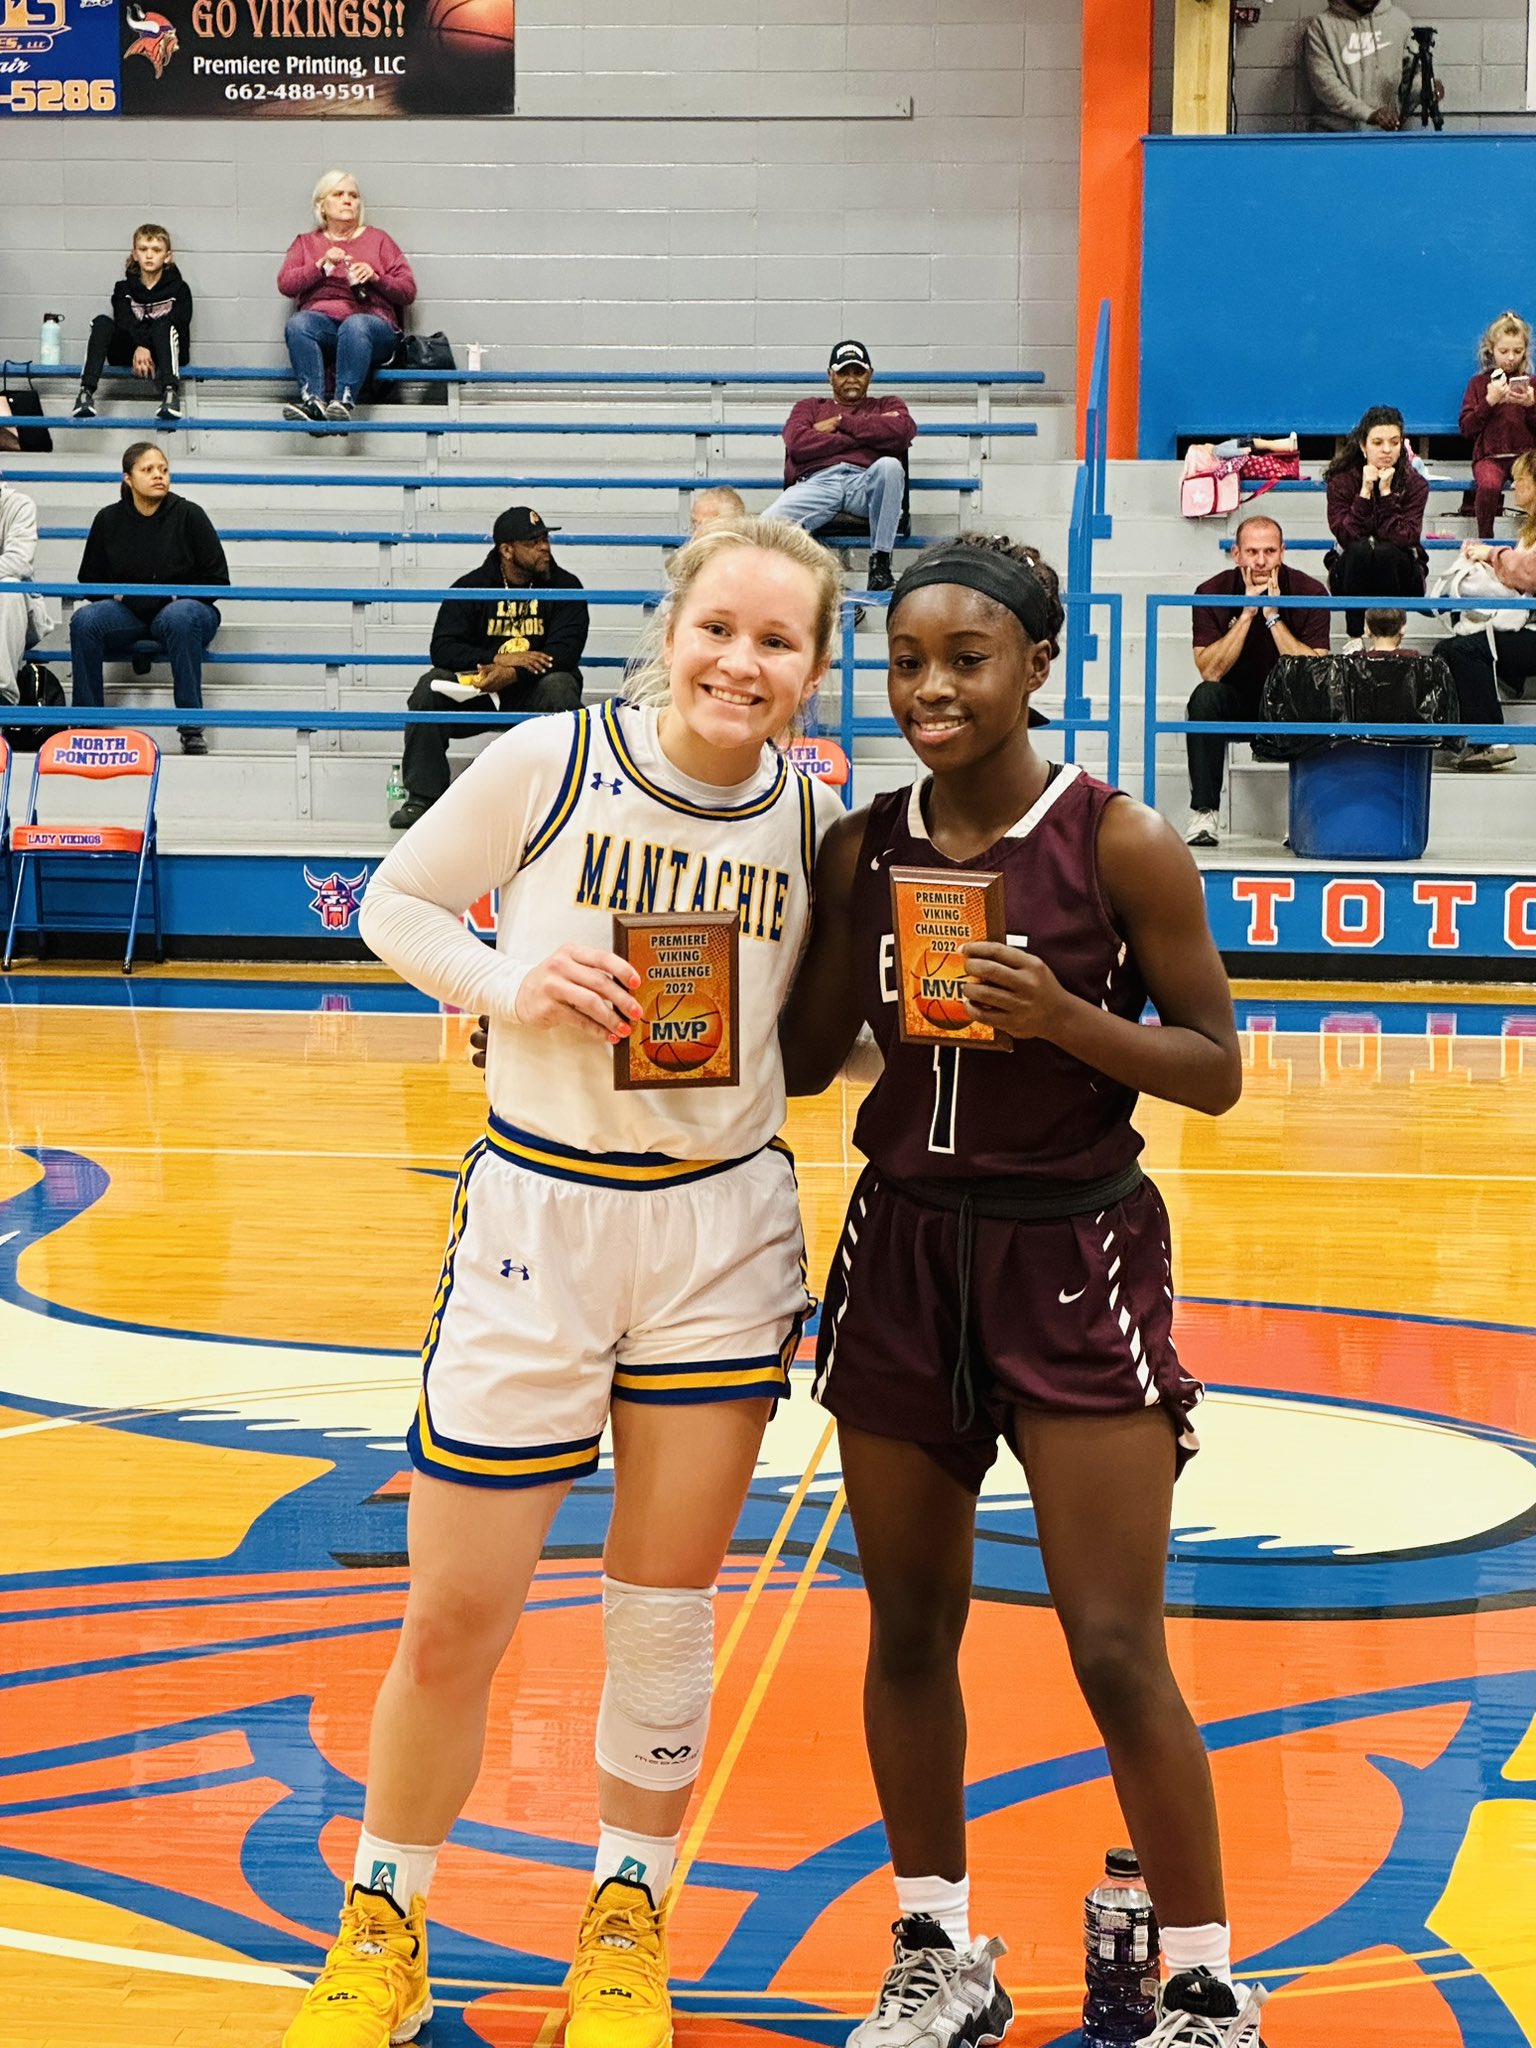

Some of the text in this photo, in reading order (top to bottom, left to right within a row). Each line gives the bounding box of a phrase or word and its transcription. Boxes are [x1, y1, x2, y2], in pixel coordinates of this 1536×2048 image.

[192, 0, 405, 38] GO VIKINGS!!
[193, 56, 406, 78] Premiere Printing, LLC
[224, 83, 375, 100] 662-488-9591
[71, 737, 126, 751] NORTH
[55, 750, 138, 765] PONTOTOC
[28, 834, 102, 845] LADY VIKINGS
[575, 831, 790, 943] MANTACHIE
[915, 891, 966, 905] PREMIERE
[923, 908, 960, 921] VIKING
[915, 923, 971, 937] CHALLENGE
[651, 934, 708, 947] PREMIERE
[931, 940, 957, 952] 2022
[658, 949, 700, 962] VIKING
[647, 965, 711, 979] CHALLENGE
[665, 982, 694, 994] 2022
[652, 1020, 708, 1041] MVP
